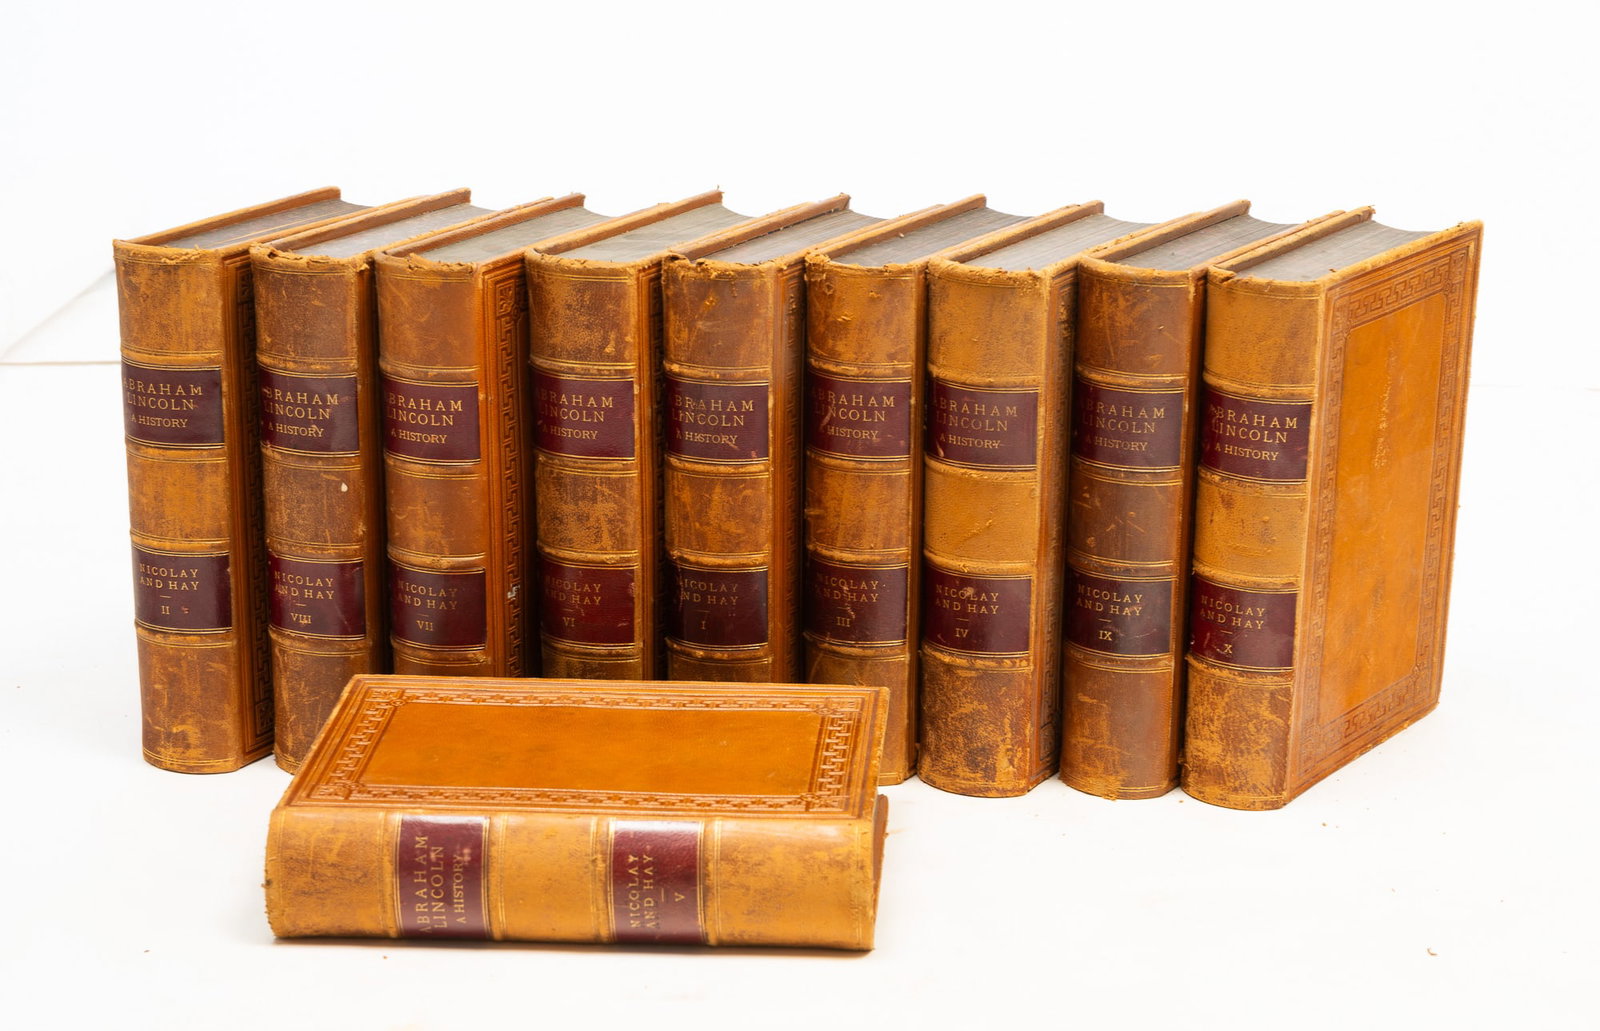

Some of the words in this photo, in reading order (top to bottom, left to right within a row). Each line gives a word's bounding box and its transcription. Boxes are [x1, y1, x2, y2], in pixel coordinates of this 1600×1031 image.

[127, 392, 194, 410] LINCOLN
[131, 414, 137, 422] A
[138, 415, 188, 428] HISTORY
[387, 408, 454, 426] LINCOLN
[276, 423, 324, 437] HISTORY
[399, 429, 447, 444] HISTORY
[550, 425, 598, 440] HISTORY
[827, 425, 879, 439] HISTORY
[1212, 417, 1288, 444] LINCOLN
[685, 432, 738, 444] HISTORY
[948, 434, 1001, 449] HISTORY
[1095, 435, 1148, 451] HISTORY
[1215, 442, 1221, 452] A
[1224, 444, 1279, 461] HISTORY
[140, 563, 199, 578] NICOLAY
[140, 577, 163, 589] AND
[169, 581, 199, 590] HAY
[274, 570, 334, 587] NICOLAY
[304, 589, 334, 600] HAY
[572, 594, 601, 606] HAY
[707, 595, 738, 606] HAY
[847, 592, 879, 602] HAY
[161, 606, 170, 615] II
[427, 599, 457, 610] HAY
[967, 604, 999, 614] HAY
[1109, 605, 1142, 616] HAY
[290, 612, 312, 625] VIII
[563, 616, 575, 627] VI
[836, 616, 851, 627] III
[1232, 617, 1264, 630] HAY
[416, 620, 434, 631] VII
[955, 628, 969, 638] IV
[1099, 630, 1112, 641] IX
[1224, 644, 1232, 654] X
[643, 854, 654, 889] HAY
[414, 836, 432, 933] ABRAHAM
[431, 846, 447, 928] LINCOLN
[453, 854, 465, 913] HISTORY
[628, 854, 640, 928] NICOLAY
[674, 891, 685, 902] V
[643, 897, 656, 928] AND
[456, 916, 466, 924] A
